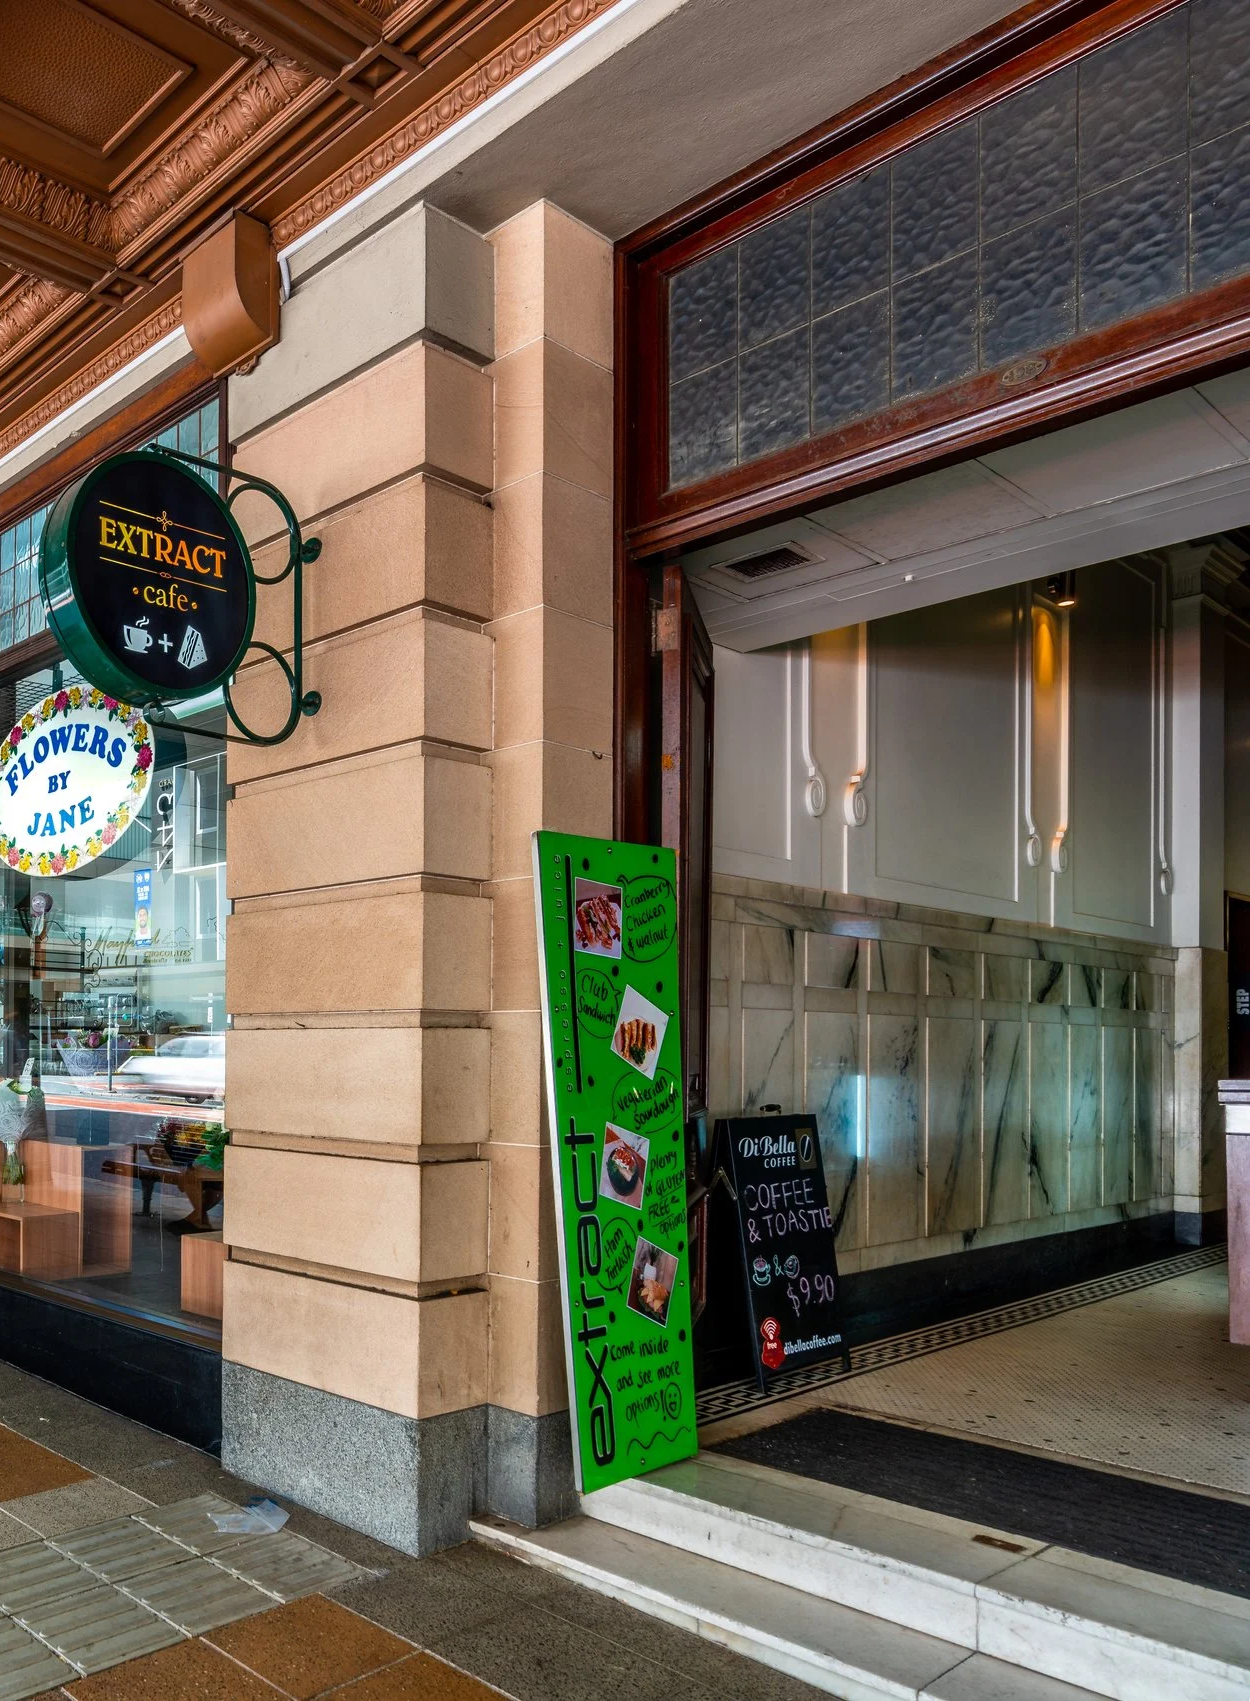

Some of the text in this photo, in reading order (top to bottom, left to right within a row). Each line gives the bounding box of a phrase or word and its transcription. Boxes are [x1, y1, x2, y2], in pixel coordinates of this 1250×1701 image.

[99, 516, 226, 578] EXTRACT
[143, 584, 188, 612] cafe
[5, 723, 126, 796] FLOWERS
[48, 770, 71, 793] BY
[27, 796, 94, 837] JANE
[553, 855, 565, 920] juice
[624, 881, 670, 909] Cranberry
[626, 903, 666, 932] Chicken
[636, 924, 669, 949] walnut
[581, 974, 608, 1002] Club
[1236, 989, 1250, 1015] STEP
[578, 995, 616, 1027] Sandwich
[559, 969, 573, 1092] espresso
[764, 1156, 797, 1168] COFFEE
[656, 1169, 685, 1196] GLUTEN
[744, 1178, 814, 1211] COFFEE
[648, 1199, 670, 1223] FREE
[660, 1207, 686, 1239] options
[747, 1206, 832, 1243] & TOASTIE
[604, 1228, 624, 1259] Ham
[564, 1116, 615, 1467] extract
[787, 1274, 834, 1318] $9.90
[639, 1336, 669, 1357] inside
[767, 1342, 778, 1350] free
[783, 1334, 842, 1355] dibellacoffee.com
[616, 1360, 681, 1393] and see more
